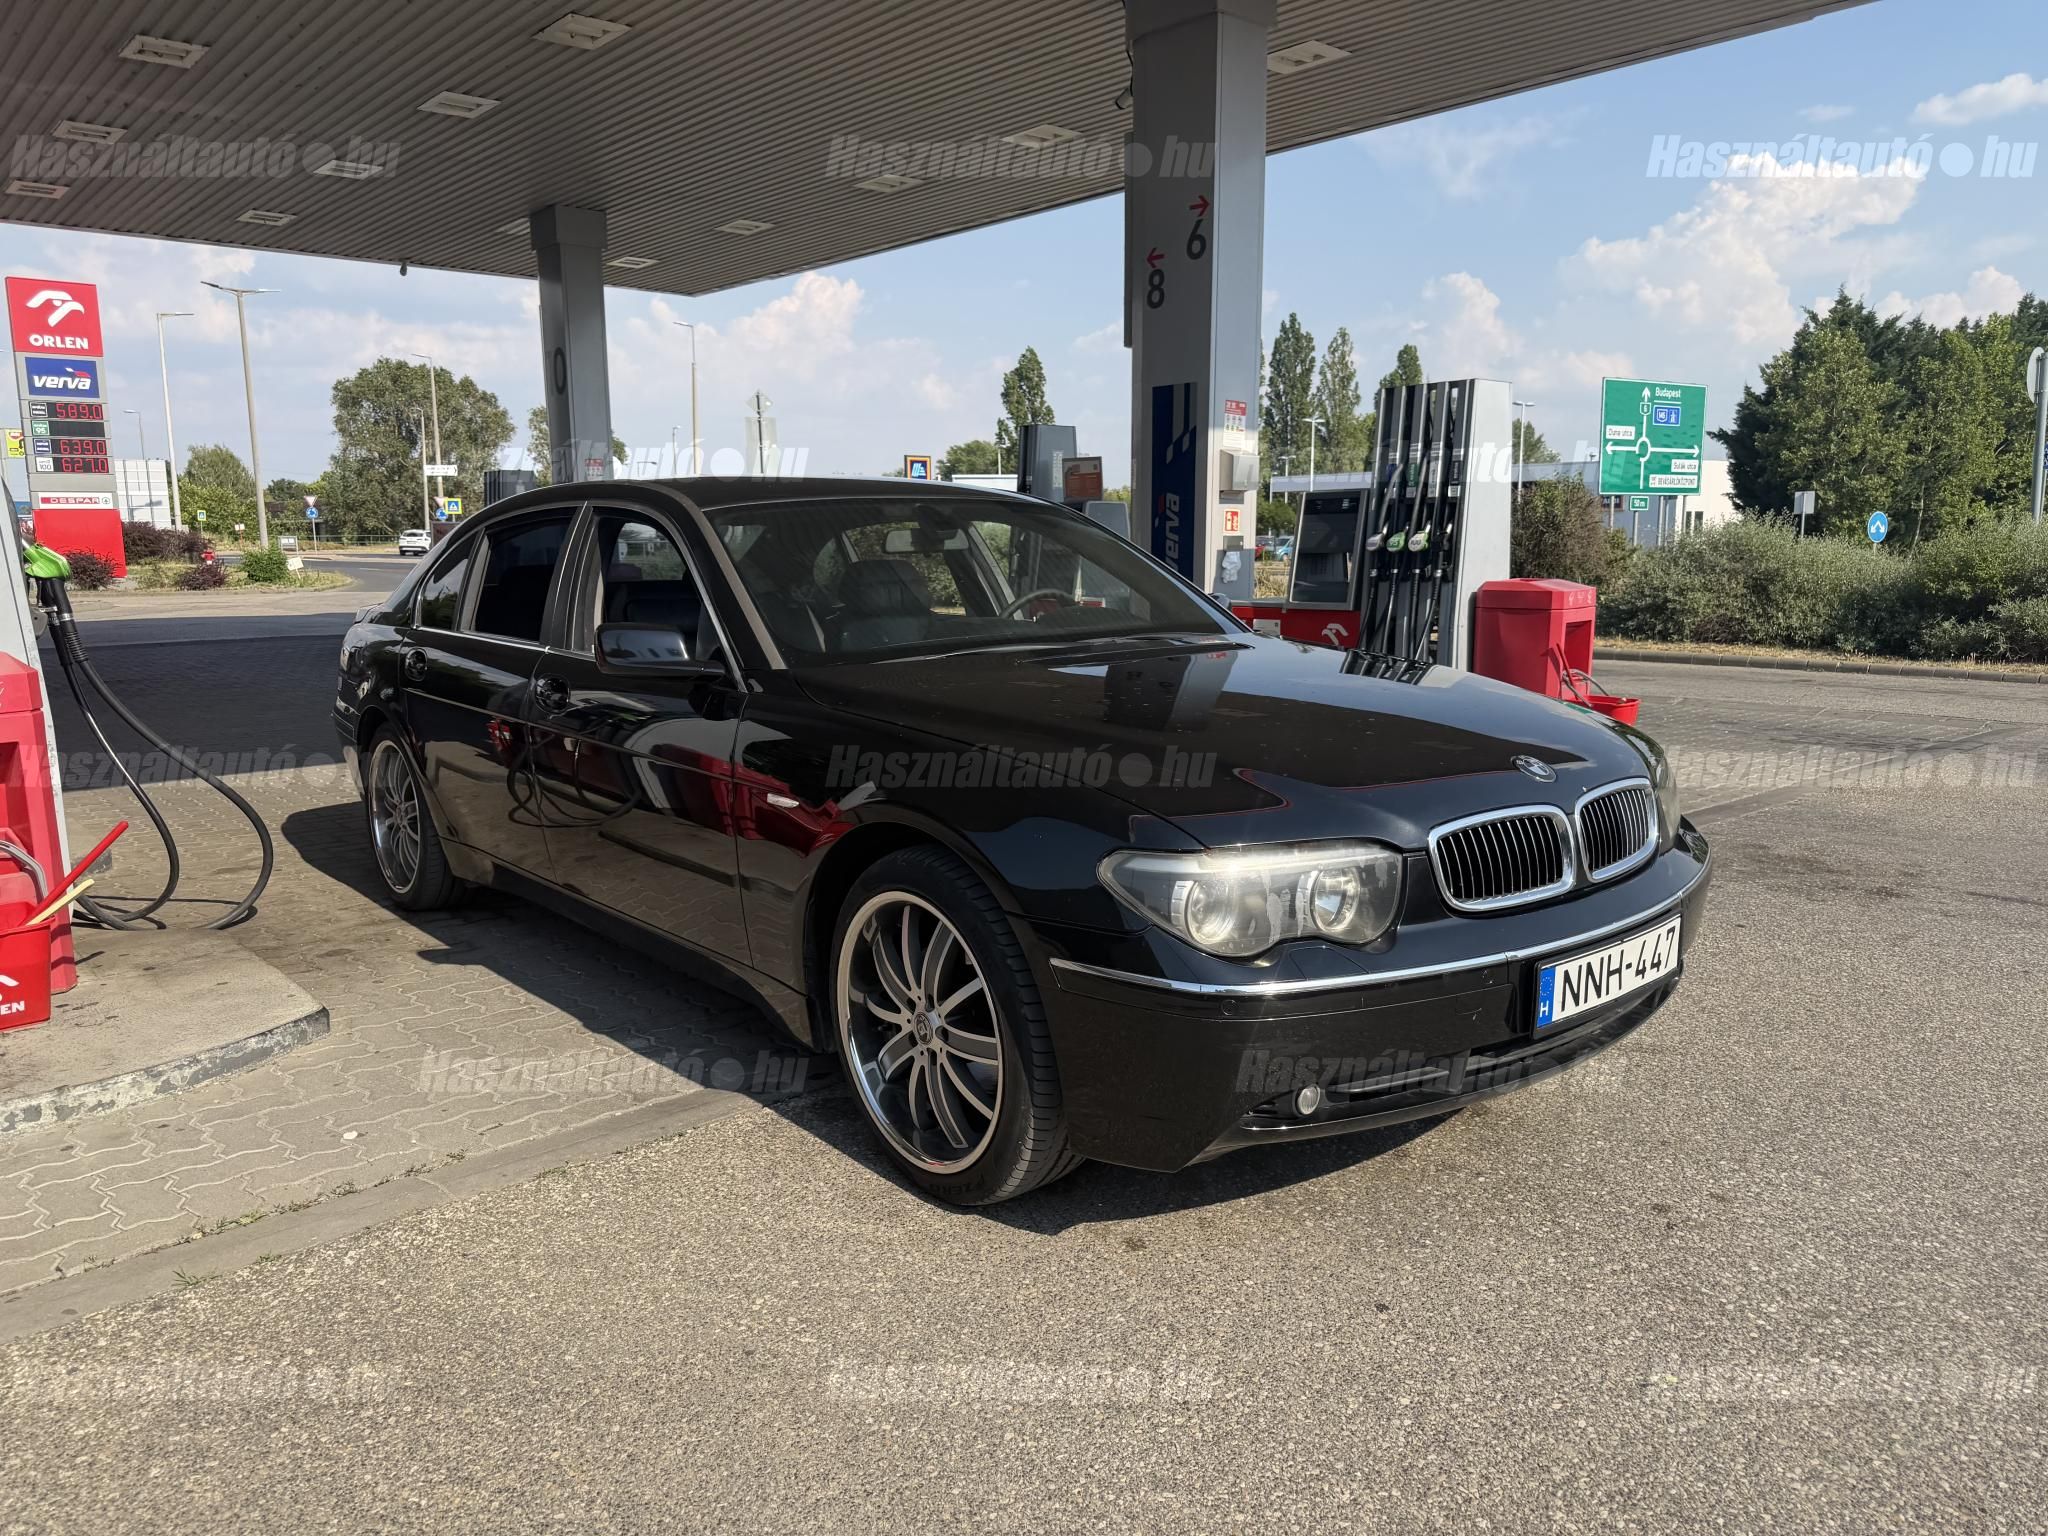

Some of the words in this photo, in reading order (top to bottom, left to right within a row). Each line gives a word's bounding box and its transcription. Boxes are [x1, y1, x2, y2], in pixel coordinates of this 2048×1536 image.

[1186, 218, 1207, 260] 6
[1146, 268, 1165, 309] 8
[29, 334, 89, 350] ORLEN
[33, 375, 92, 390] verva
[1655, 387, 1681, 399] Budapest
[60, 439, 106, 455] 639.0
[62, 457, 108, 473] 627.0
[1539, 1000, 1549, 1018] H
[1561, 925, 1676, 1012] NNH-447
